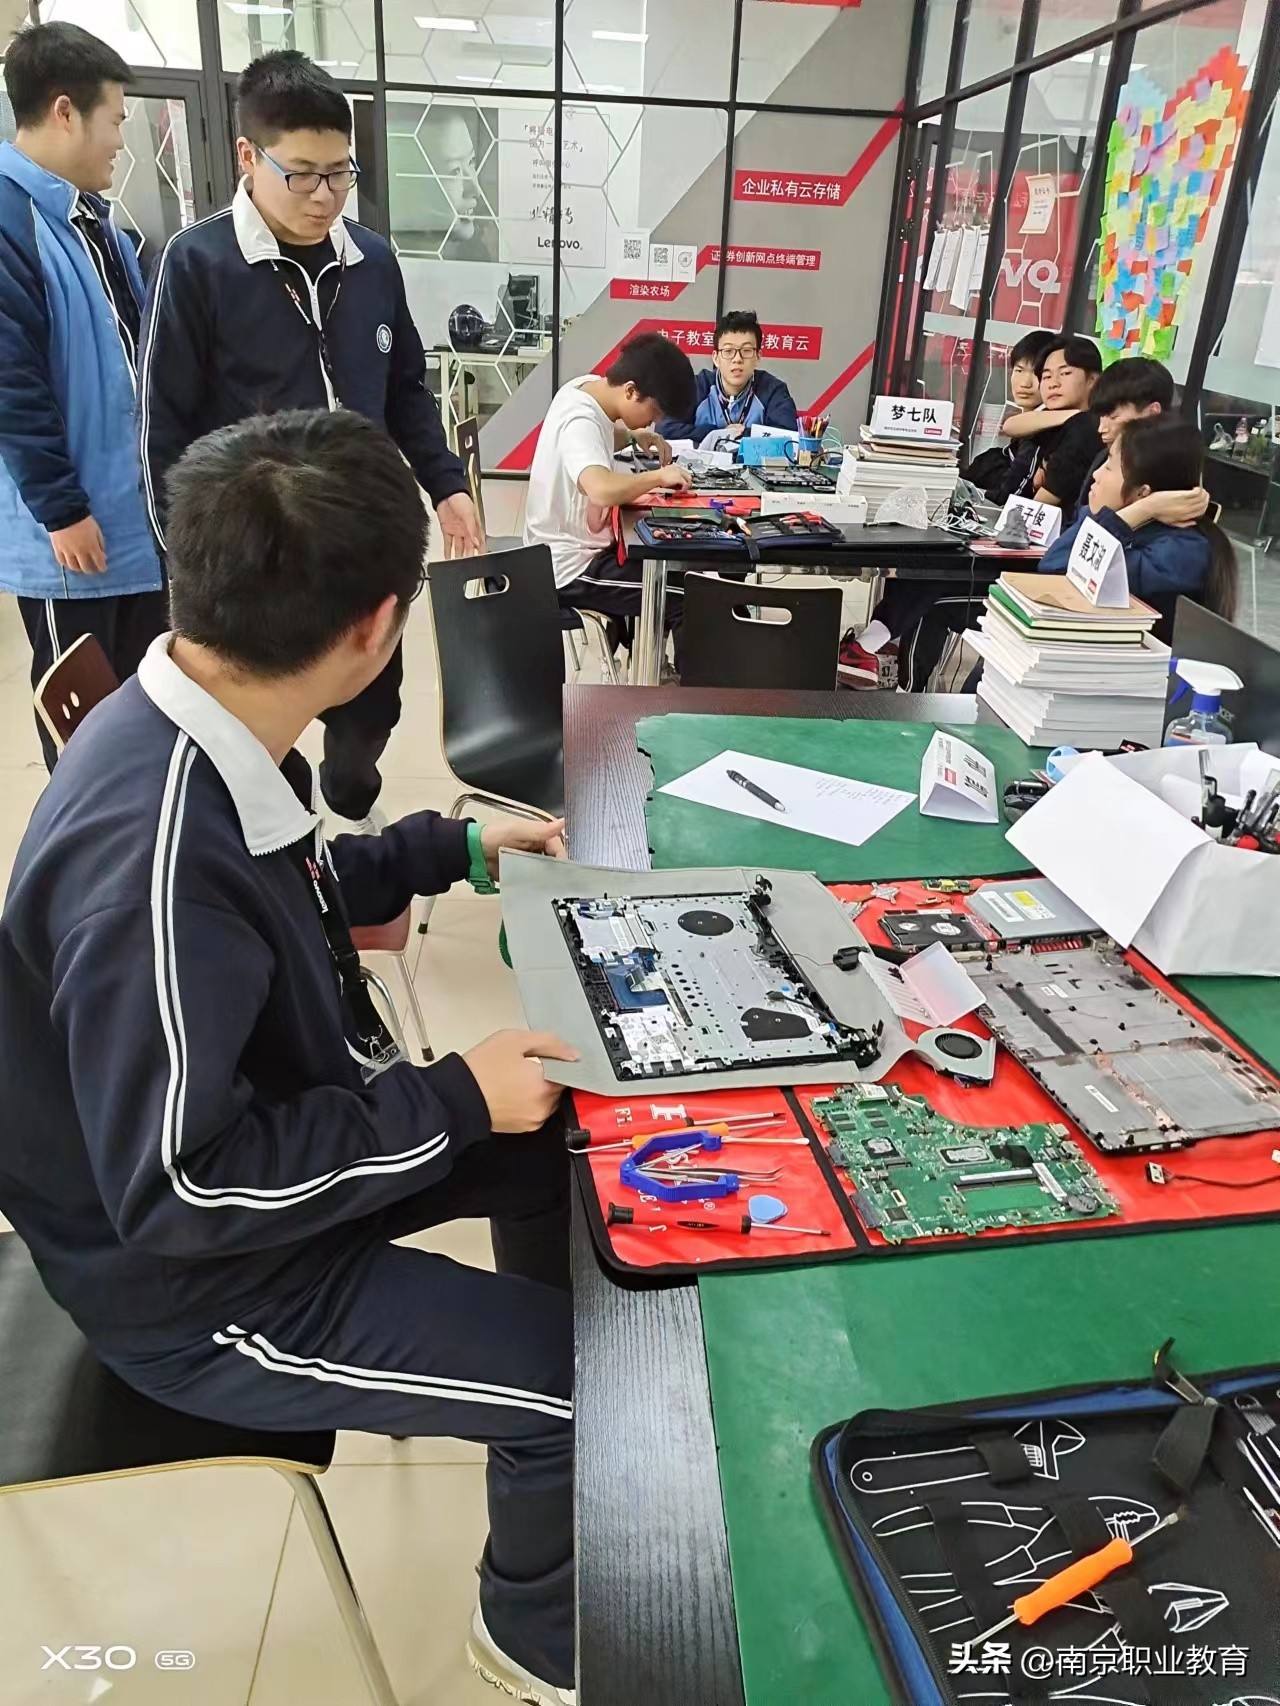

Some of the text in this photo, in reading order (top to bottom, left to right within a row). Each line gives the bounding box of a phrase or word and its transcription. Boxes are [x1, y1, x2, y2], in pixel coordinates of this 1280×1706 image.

[742, 178, 841, 200] 企业私有云存储
[537, 236, 580, 250] Leovo
[711, 249, 816, 267] 证券创新网点终端管理
[629, 283, 670, 298] 渲染农场
[760, 333, 810, 351] 教育云
[891, 404, 937, 423] 梦七队
[1015, 504, 1046, 526] 子俊
